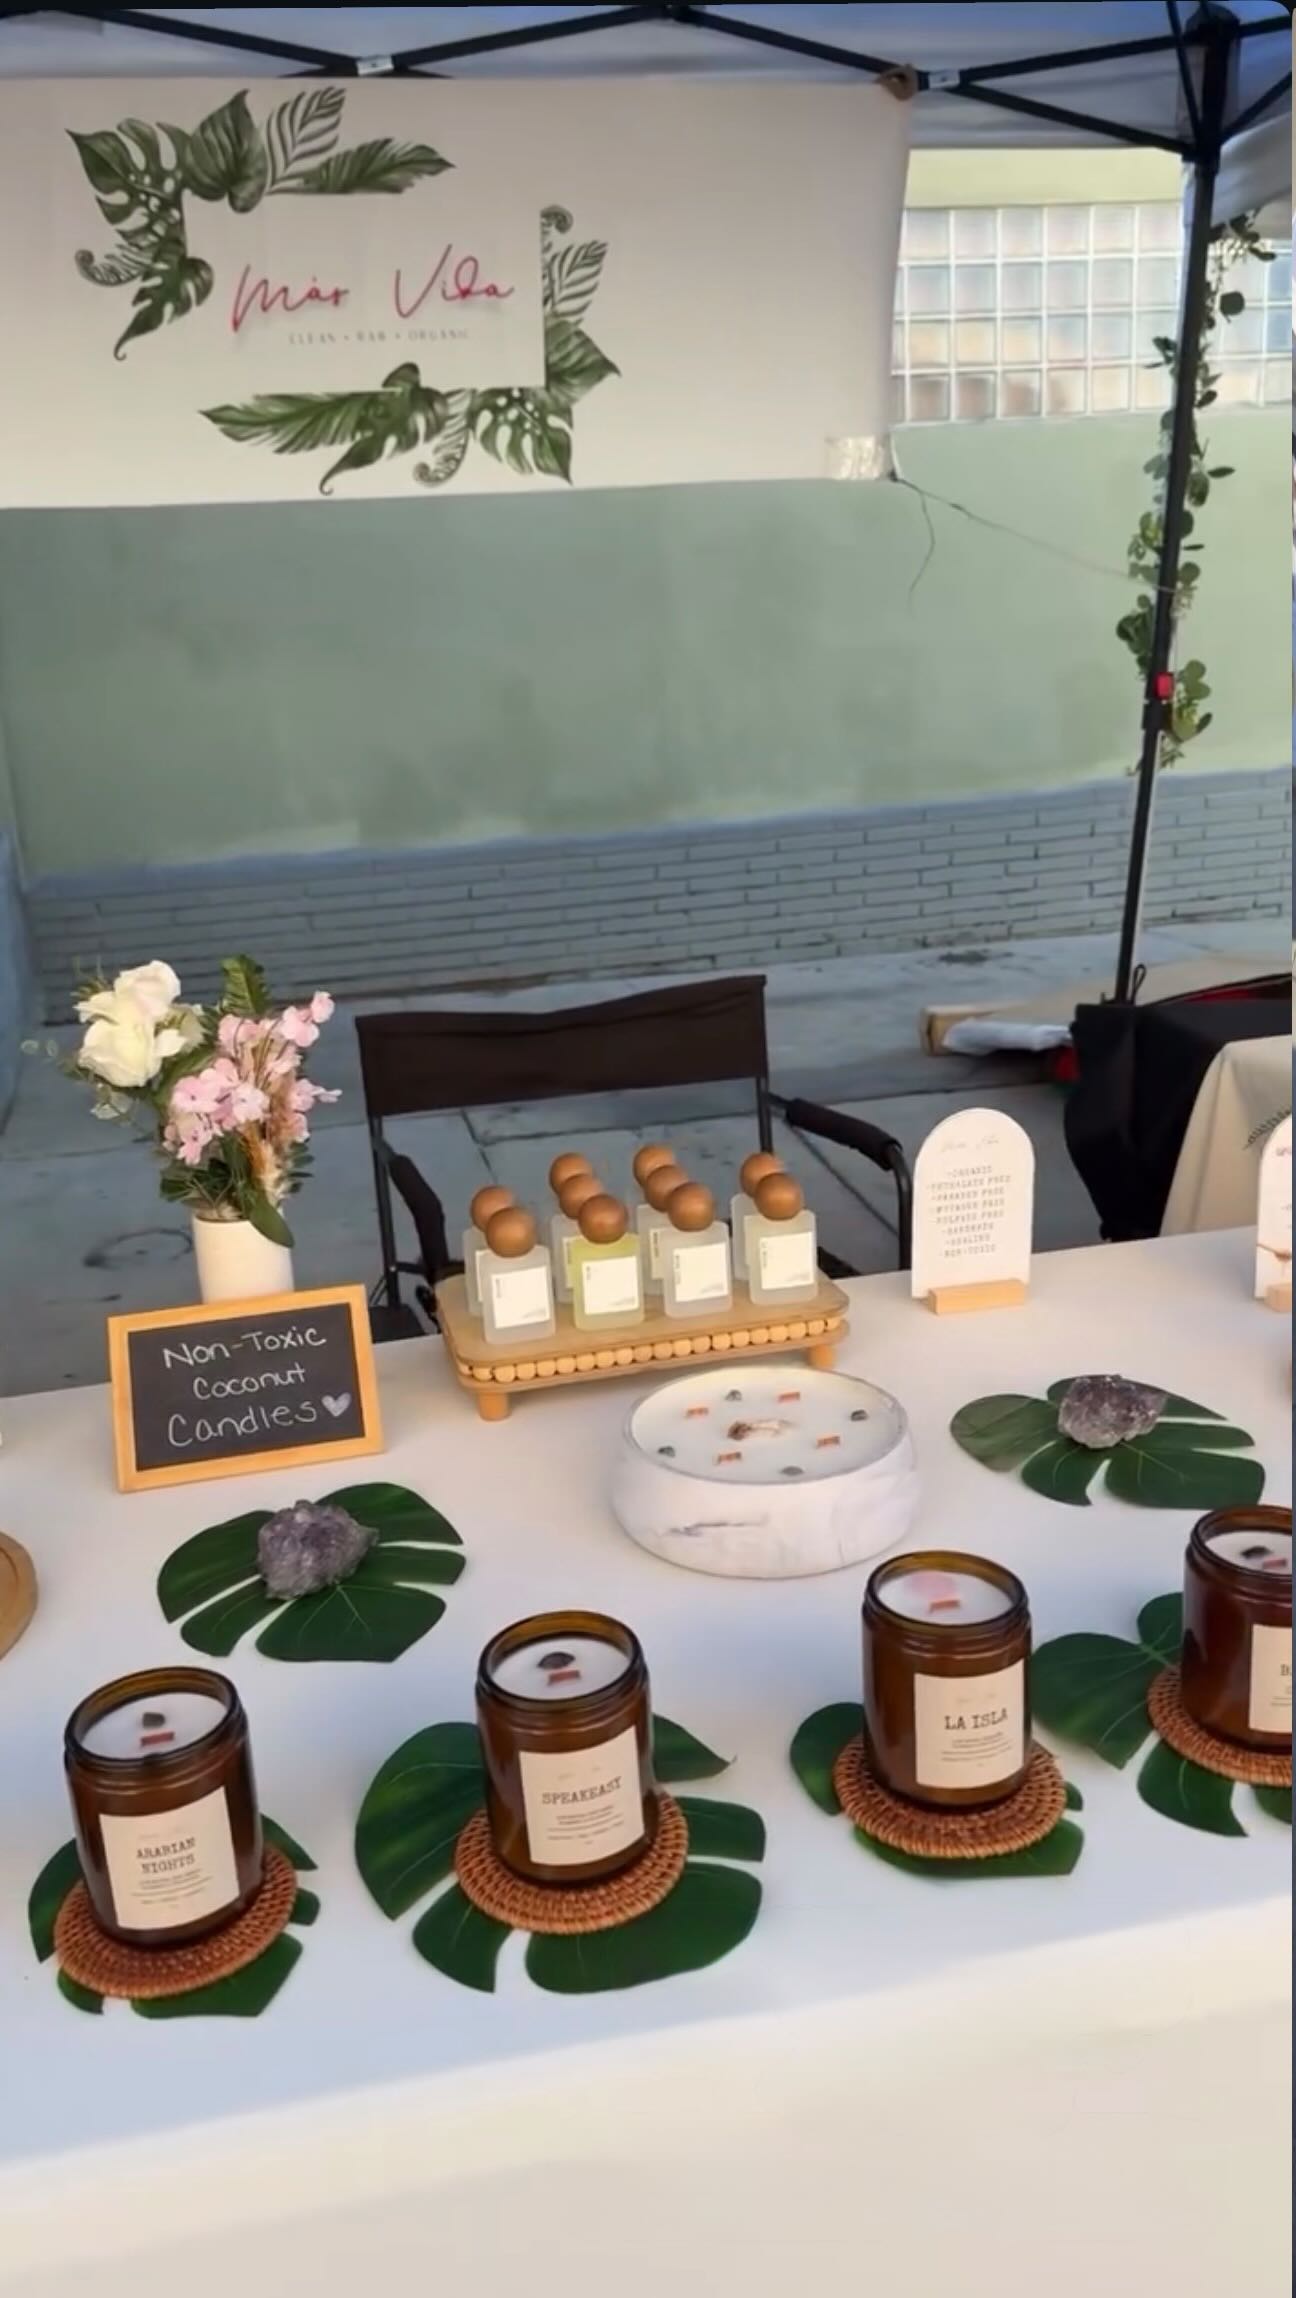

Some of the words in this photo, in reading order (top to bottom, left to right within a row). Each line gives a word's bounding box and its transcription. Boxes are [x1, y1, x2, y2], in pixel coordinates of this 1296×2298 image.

[394, 243, 514, 319] Vida
[288, 331, 336, 345] CLEAN
[162, 1326, 327, 1369] Non-Toxic
[192, 1362, 306, 1400] Coconut
[168, 1401, 317, 1448] Candles
[944, 1715, 966, 1730] LA
[971, 1708, 1008, 1729] ISLA
[541, 1776, 621, 1805] SPEAKEASY
[136, 1837, 196, 1859] ARABIAN
[142, 1854, 195, 1874] NIGHTS
